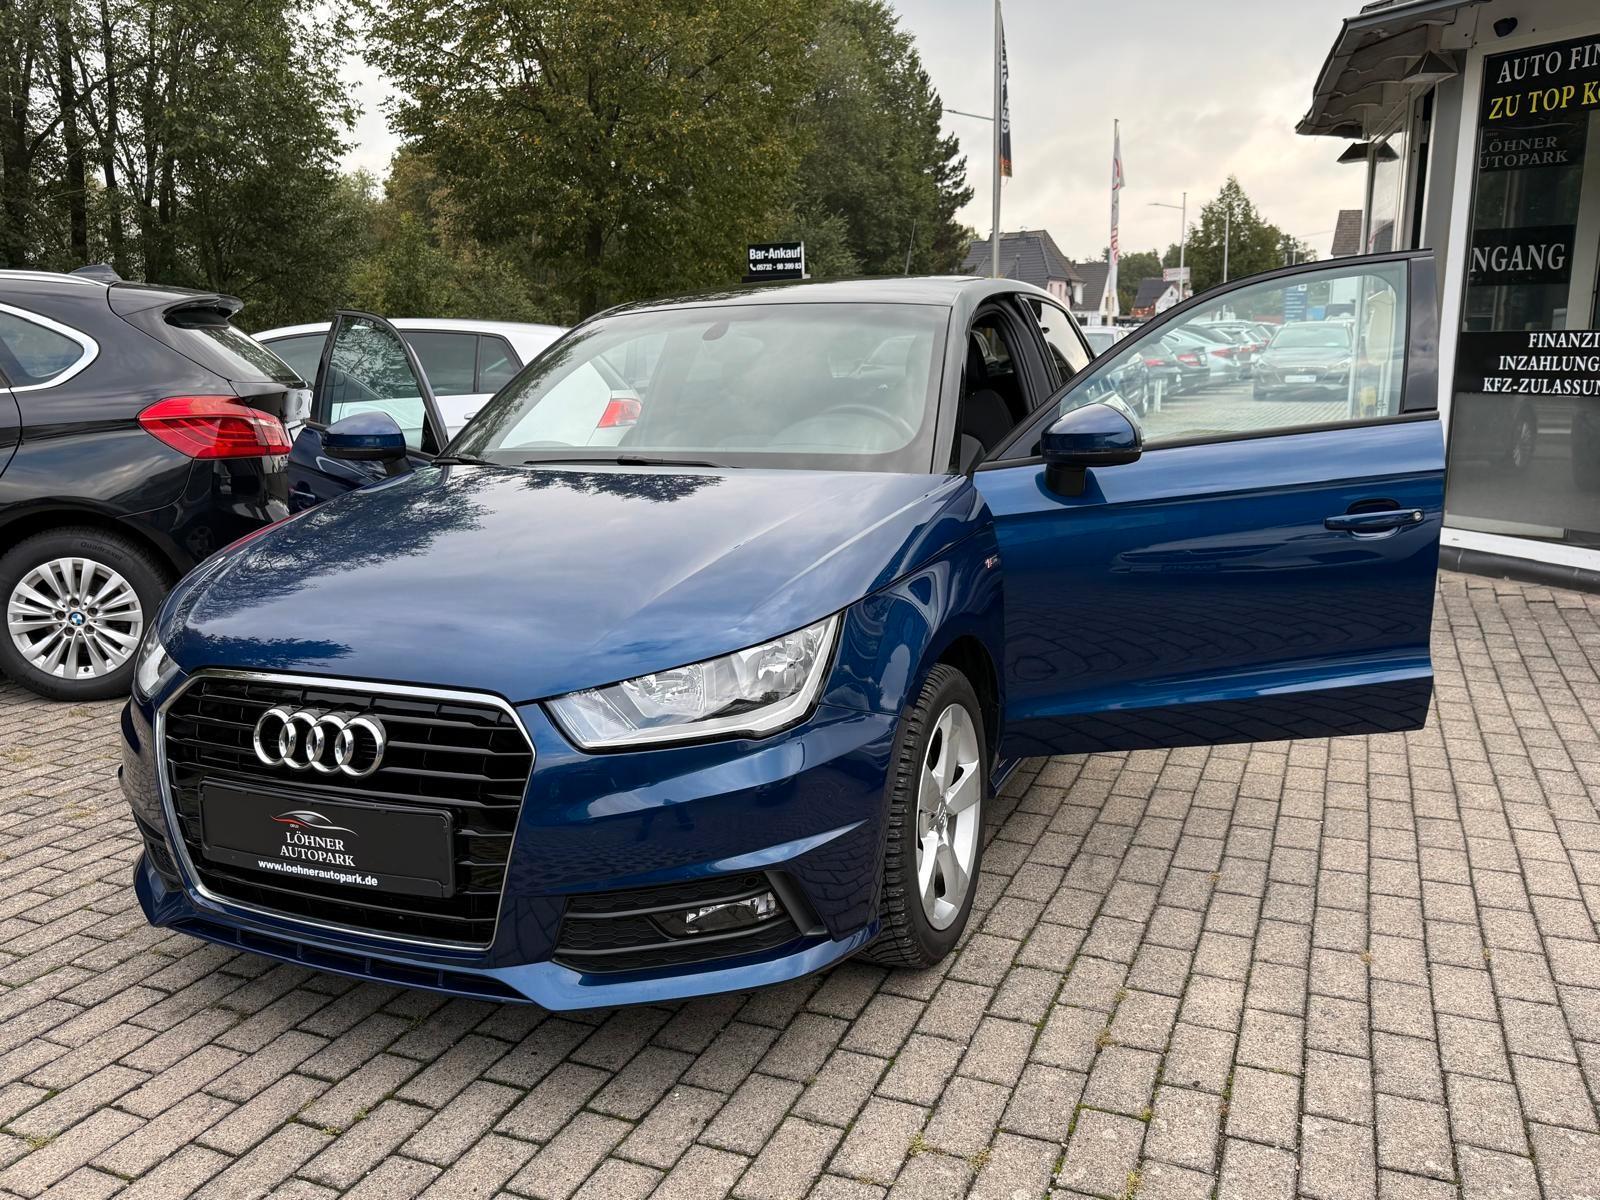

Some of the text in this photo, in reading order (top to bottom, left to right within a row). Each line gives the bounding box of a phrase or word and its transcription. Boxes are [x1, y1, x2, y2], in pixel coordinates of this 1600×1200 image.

[1497, 51, 1562, 84] AUTO
[1488, 80, 1600, 120] ZU TOP K
[749, 247, 801, 260] Bar-Ankauf
[1499, 355, 1600, 372] INZAHLUNG
[286, 831, 345, 851] LÖHNER
[280, 845, 356, 867] AUTOPARK
[259, 859, 378, 886] www.loehnerautopark.de
